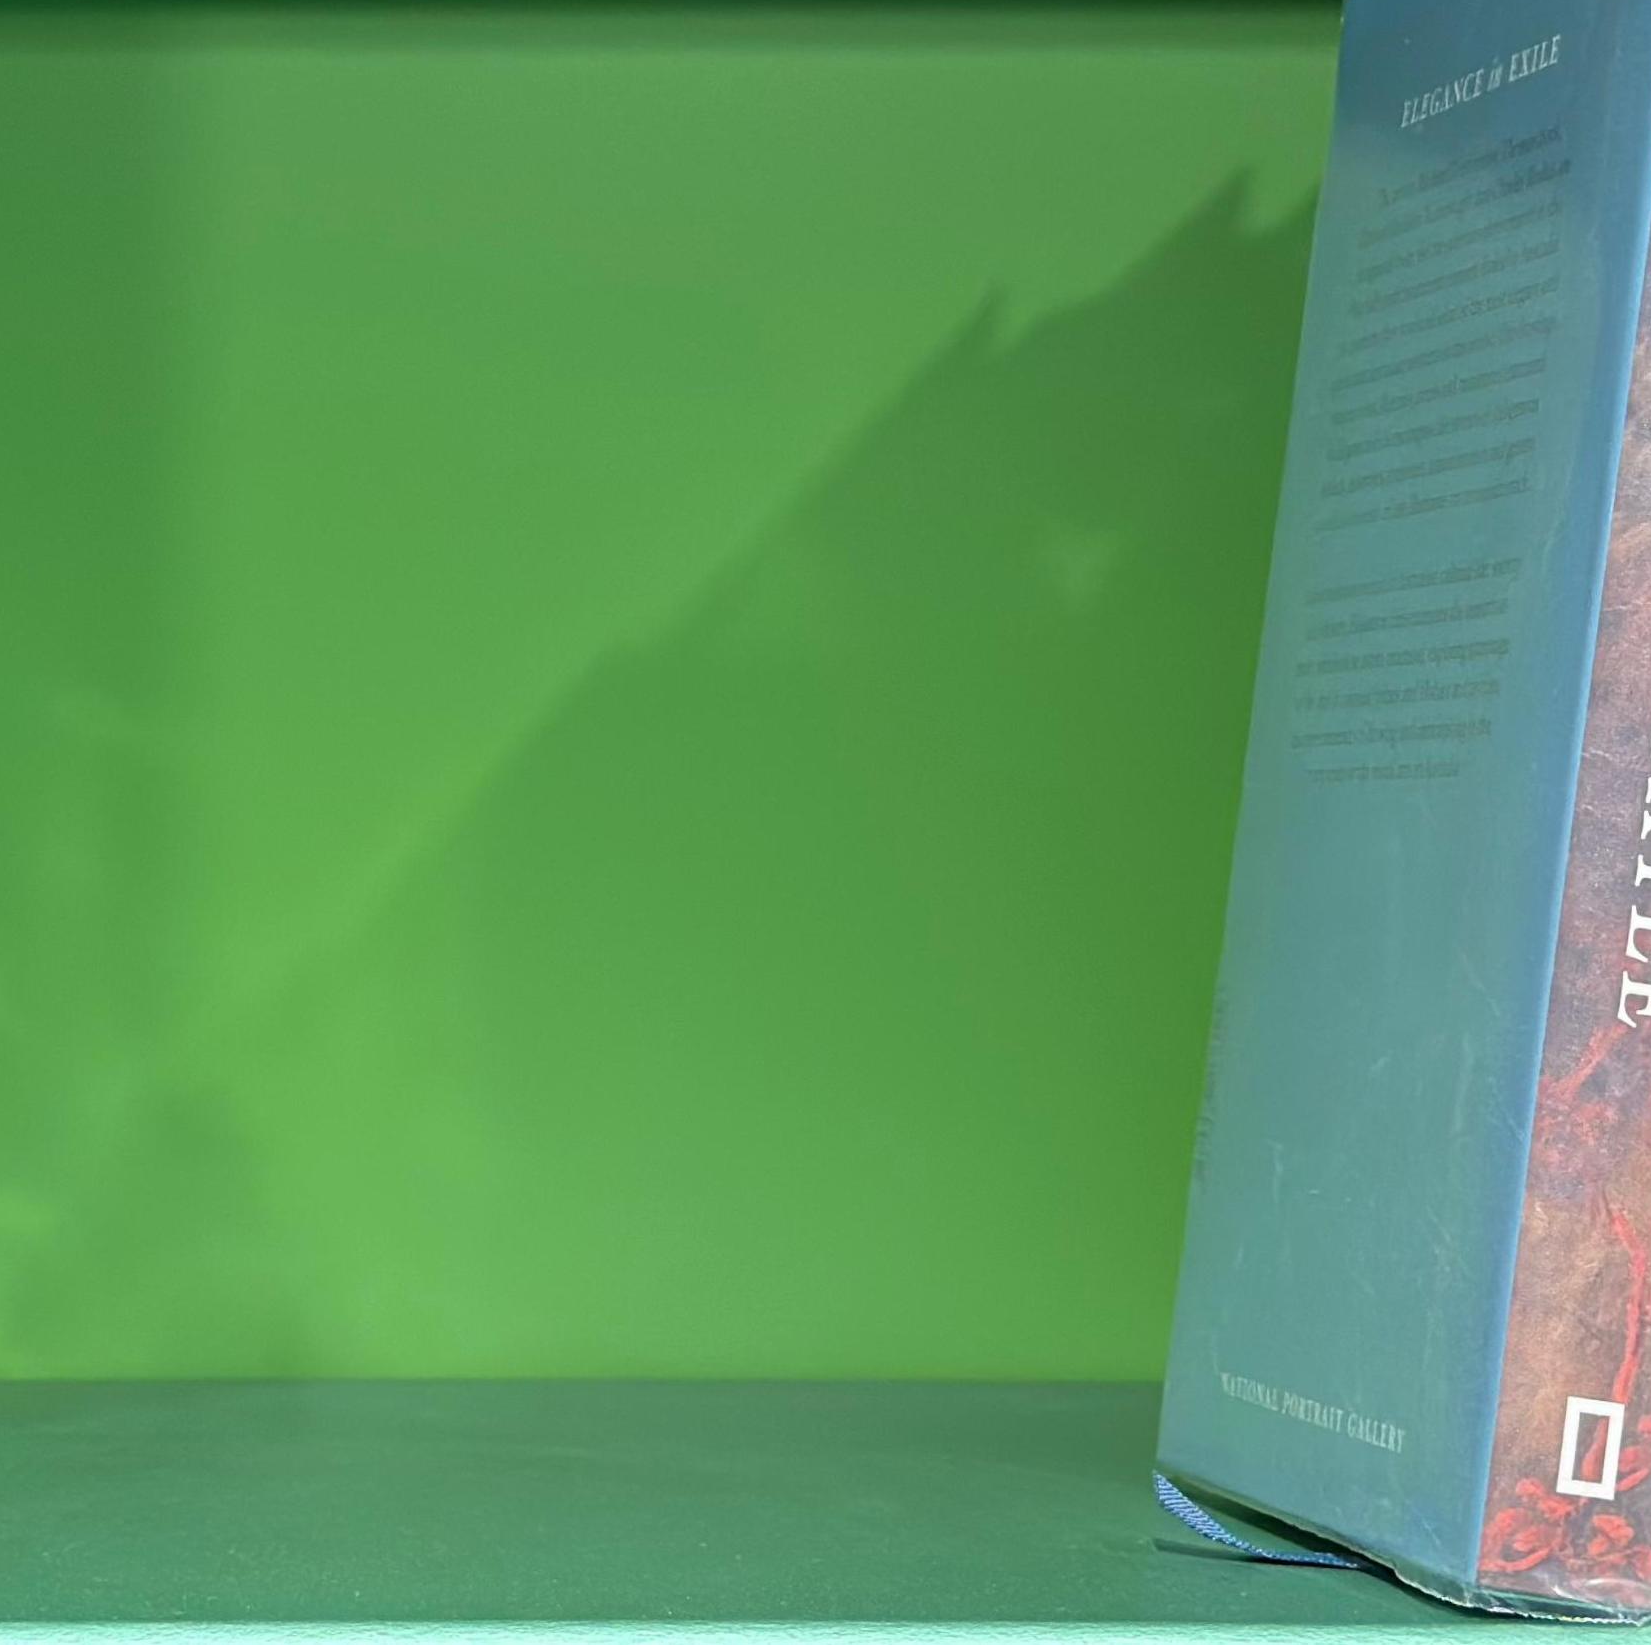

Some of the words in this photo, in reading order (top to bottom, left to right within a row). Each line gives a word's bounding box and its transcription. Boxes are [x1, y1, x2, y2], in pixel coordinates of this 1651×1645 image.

[1401, 68, 1484, 128] ELEGANCE
[1486, 56, 1504, 92] in
[1508, 34, 1561, 83] EXILE
[1220, 1372, 1278, 1412] NATIONAL
[1281, 1391, 1343, 1433] PORTRAIT
[1347, 1413, 1406, 1454] GALLERY
